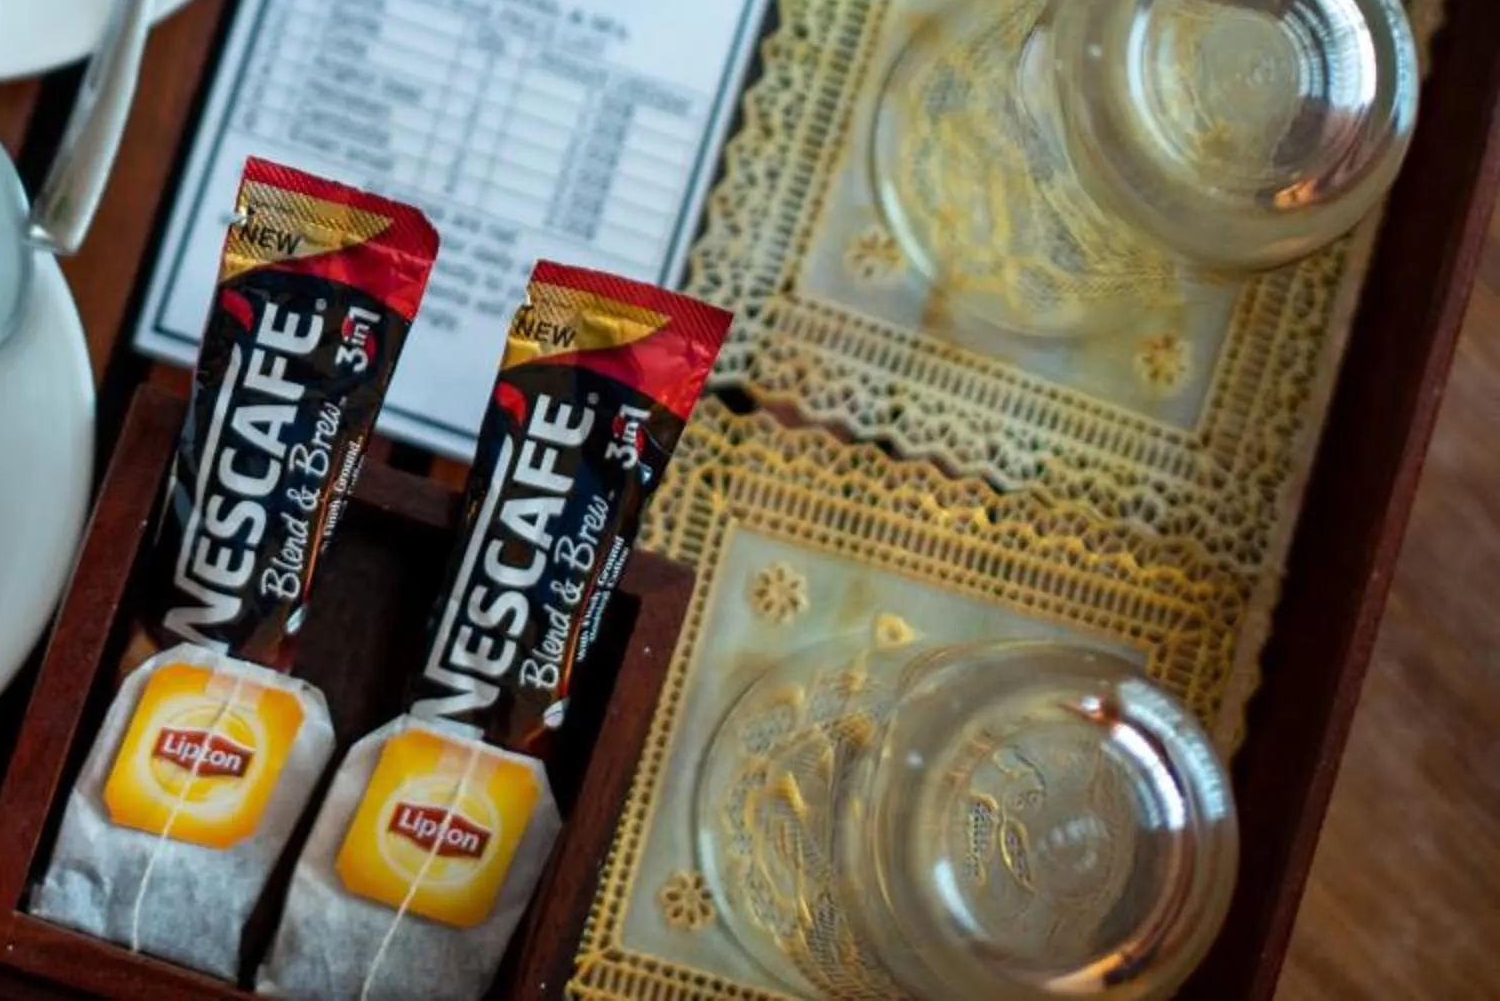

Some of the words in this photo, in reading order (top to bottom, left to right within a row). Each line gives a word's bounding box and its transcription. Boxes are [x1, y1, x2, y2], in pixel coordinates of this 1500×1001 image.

[238, 224, 303, 256] NEW
[515, 317, 577, 349] NEW
[288, 402, 341, 479] Brew
[286, 483, 322, 511] &
[260, 511, 312, 600] Blend
[553, 495, 610, 572] Brew
[549, 576, 585, 606] &
[518, 604, 572, 689] Blend
